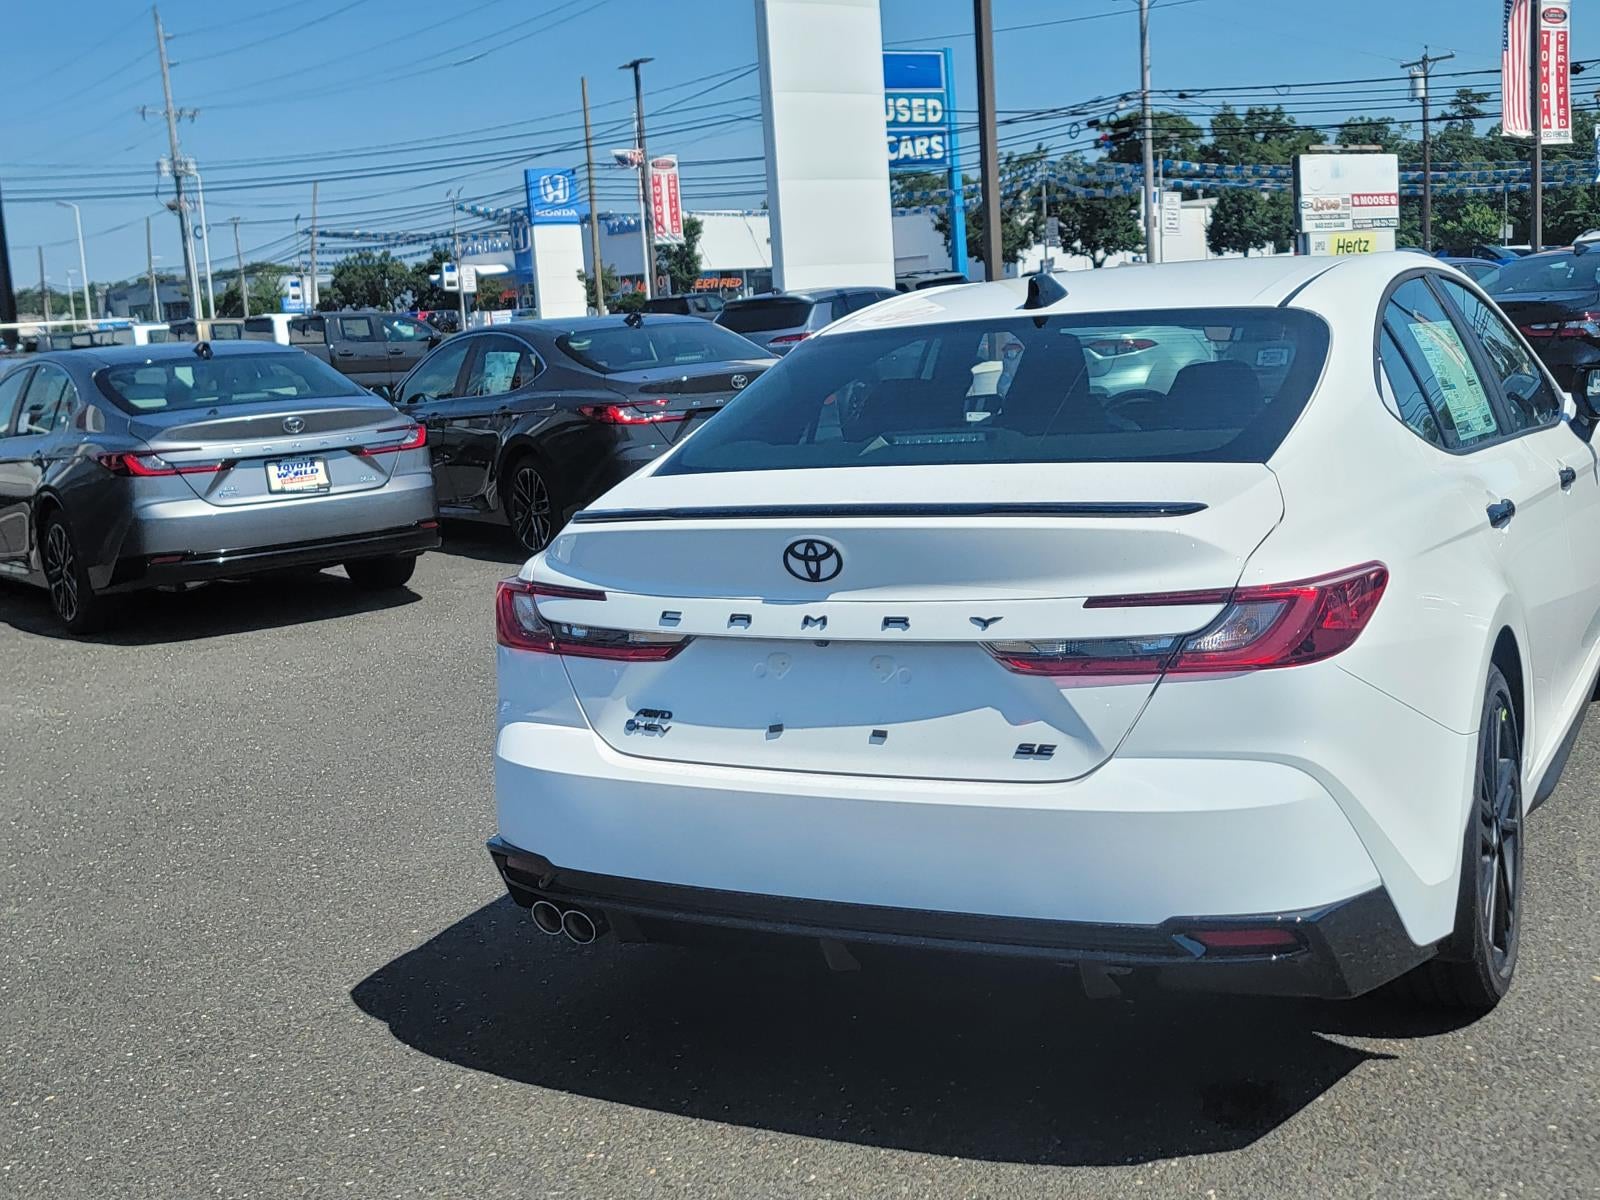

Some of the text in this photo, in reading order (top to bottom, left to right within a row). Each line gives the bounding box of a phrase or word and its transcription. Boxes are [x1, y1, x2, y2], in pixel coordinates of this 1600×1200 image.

[1541, 34, 1551, 126] TOYOTA
[1557, 33, 1567, 127] CERTIFIED
[886, 97, 943, 123] USED
[888, 135, 945, 160] CARS
[653, 175, 664, 232] TOYOTA
[1359, 195, 1390, 205] MOOSE
[535, 208, 577, 217] HONDA
[1336, 237, 1369, 255] Hertz
[694, 277, 743, 289] ERTIFIED
[277, 461, 315, 471] TOYOTA
[658, 610, 1004, 631] CAMRY
[635, 708, 673, 720] AWD
[636, 722, 672, 733] HEV
[1015, 742, 1057, 756] SE
